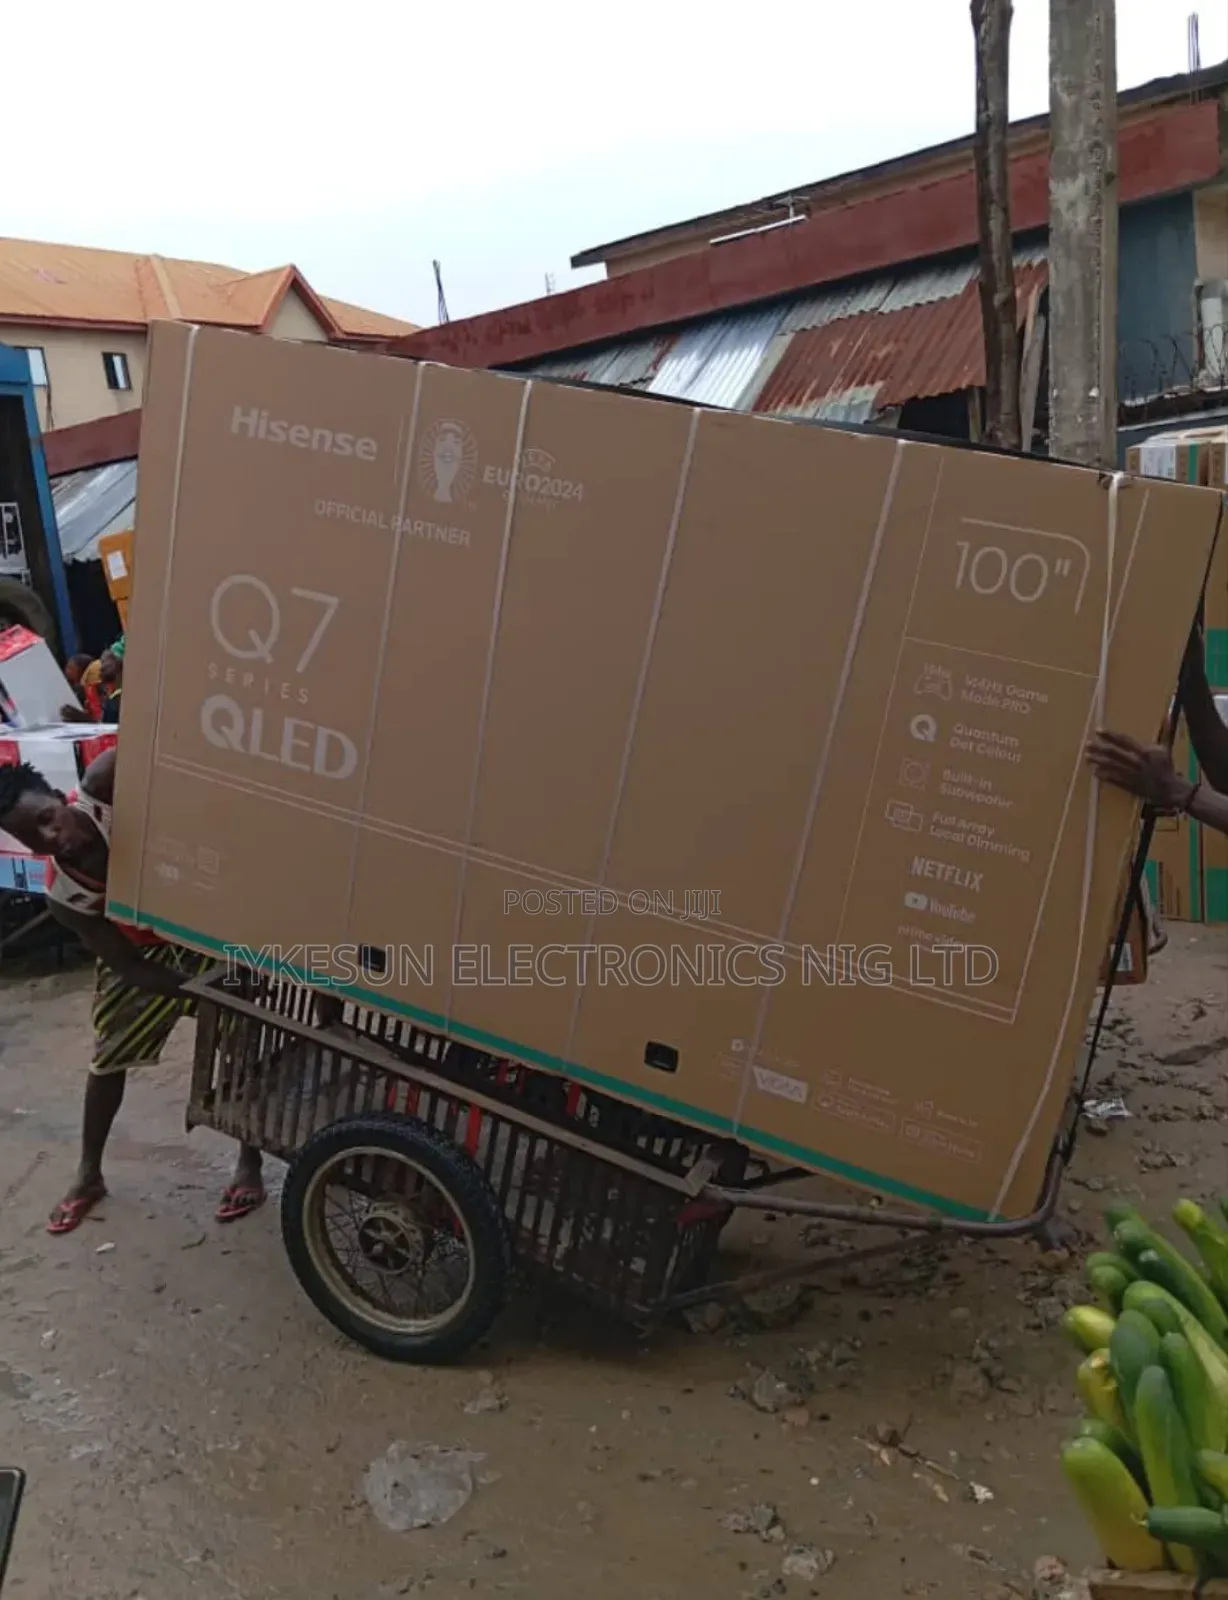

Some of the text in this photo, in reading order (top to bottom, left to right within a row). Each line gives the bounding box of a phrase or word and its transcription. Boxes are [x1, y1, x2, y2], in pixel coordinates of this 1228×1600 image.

[230, 406, 378, 462] Hisense
[314, 498, 472, 548] OFFICIAL PARTNER
[956, 541, 1072, 603] 100"
[207, 662, 310, 705] SERIES
[1006, 684, 1048, 704] Game
[201, 693, 358, 780] QLED
[949, 736, 974, 753] Dot
[952, 722, 1020, 748] Quantum
[910, 856, 983, 892] NETFLIX
[930, 896, 976, 923] YouTube
